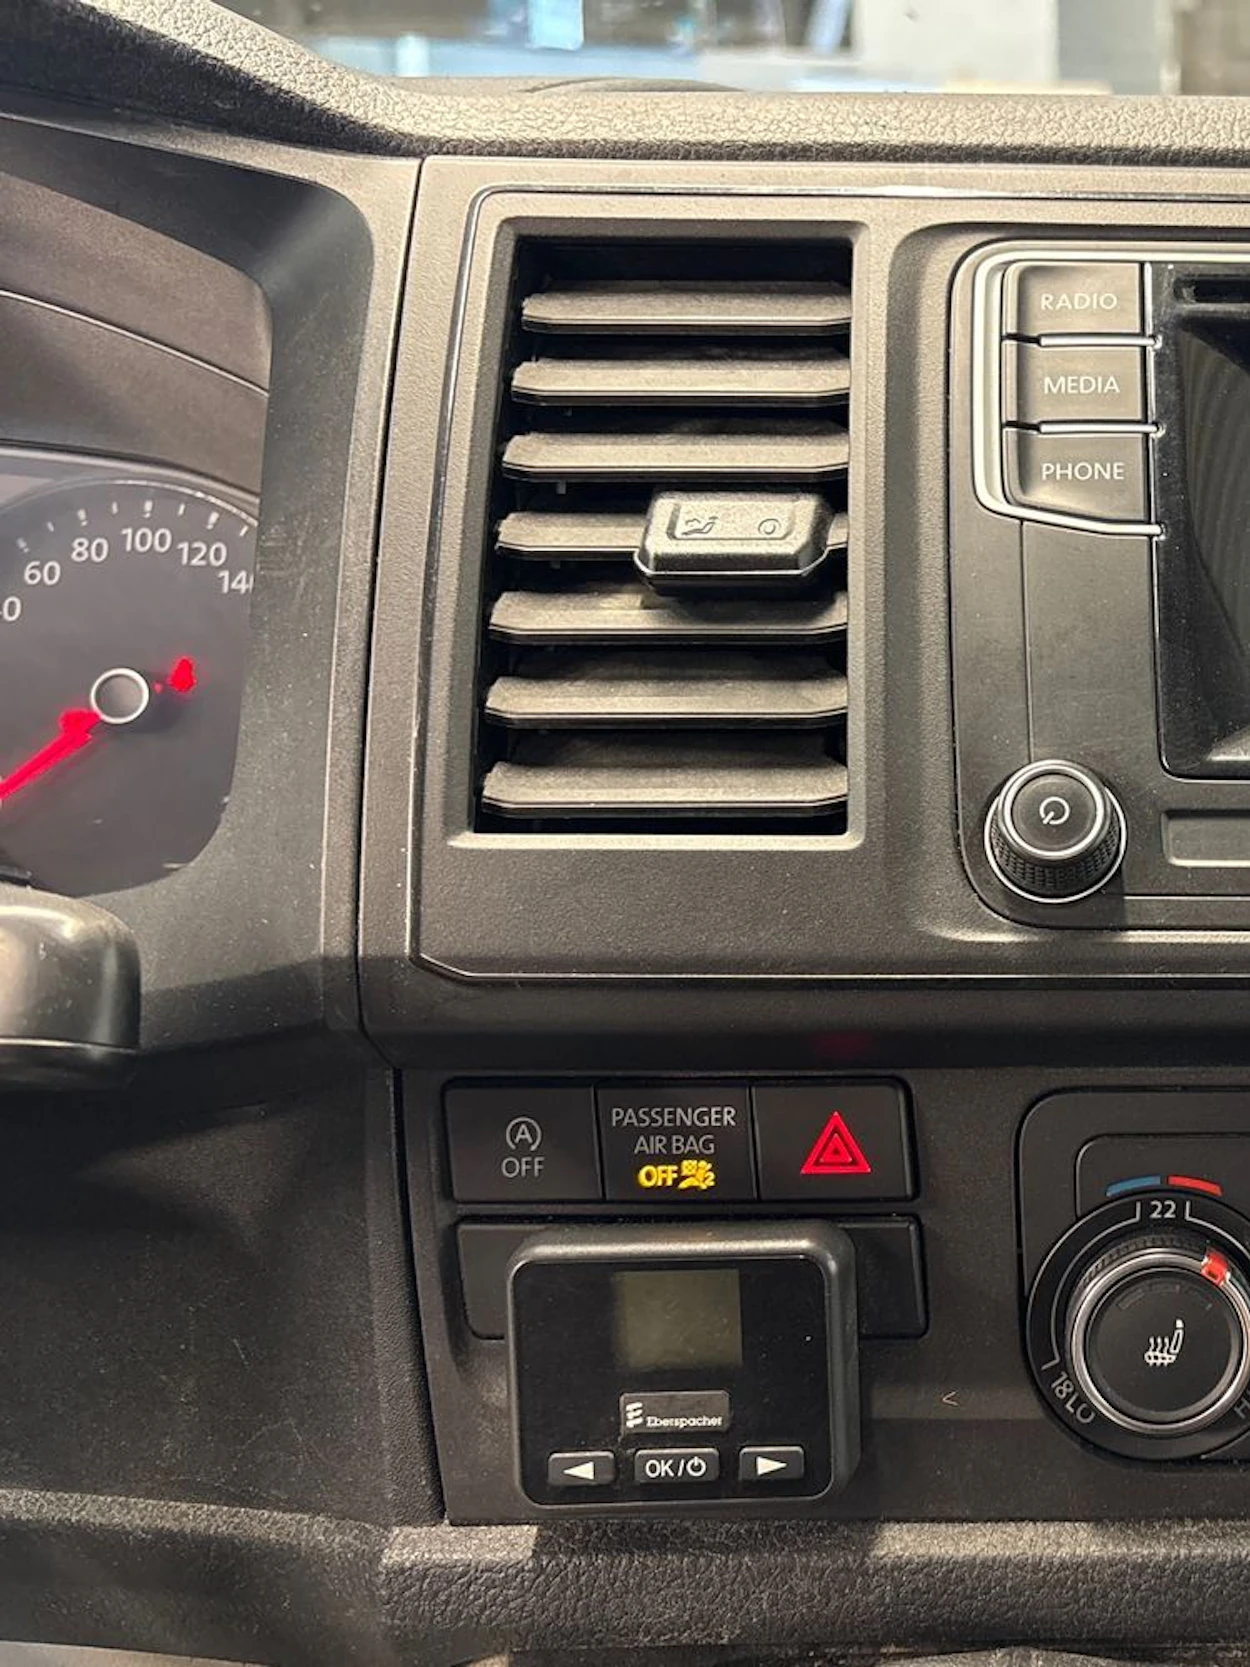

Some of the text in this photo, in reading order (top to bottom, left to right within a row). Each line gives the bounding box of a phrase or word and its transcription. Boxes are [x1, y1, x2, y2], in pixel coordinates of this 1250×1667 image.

[1040, 293, 1118, 310] RADIO
[1043, 376, 1121, 394] MEDIA
[1042, 462, 1124, 480] PHONE
[71, 538, 108, 562] 80
[122, 528, 171, 552] 100
[178, 542, 226, 566] 120
[24, 561, 60, 585] 60
[0, 597, 21, 621] 0
[613, 1107, 735, 1126] PASSENGER
[634, 1135, 714, 1154] AIR BAG
[502, 1157, 544, 1177] OFF
[638, 1164, 679, 1188] OFF
[1150, 1200, 1175, 1218] 22
